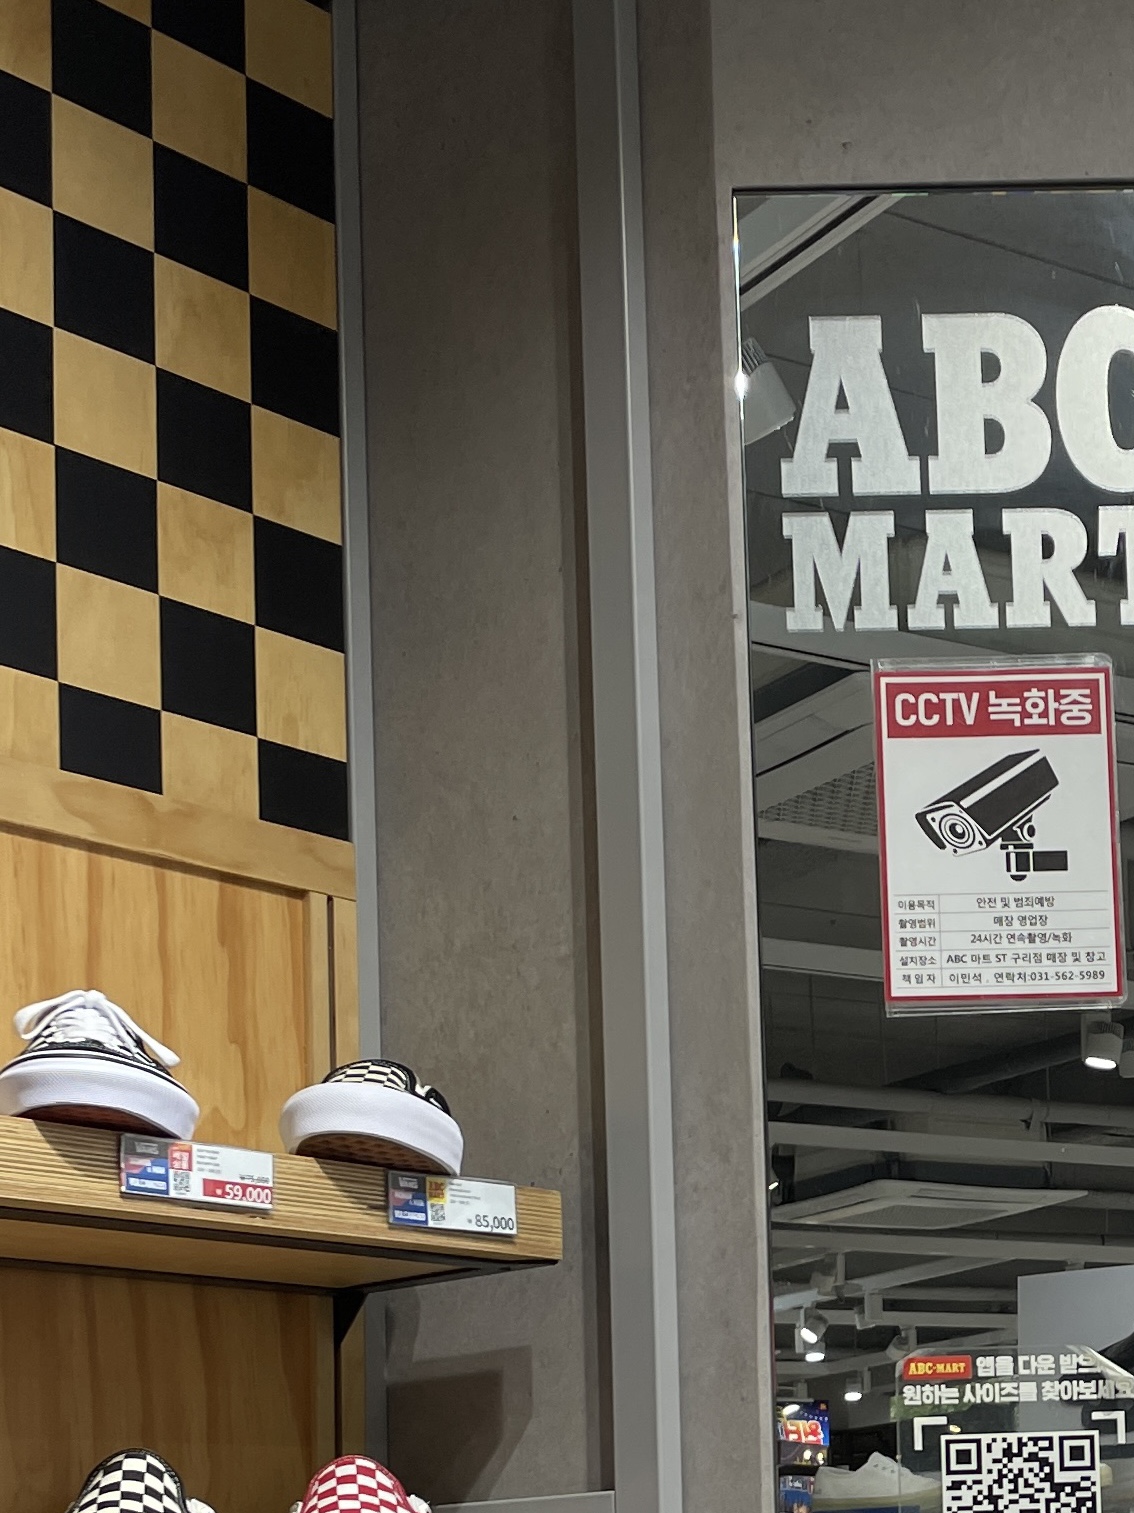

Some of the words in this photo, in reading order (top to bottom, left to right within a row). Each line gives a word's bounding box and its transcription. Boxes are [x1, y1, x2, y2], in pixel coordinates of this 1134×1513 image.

[894, 691, 980, 727] CCTV
[987, 686, 1094, 727] 녹화중
[897, 899, 936, 911] 이용목적
[976, 896, 998, 909] 안전
[1000, 897, 1012, 909] 및
[1013, 895, 1056, 908] 범죄예방
[897, 917, 937, 930] 촬영범위
[993, 915, 1015, 927] 매장
[1016, 914, 1049, 927] 영업장
[899, 936, 938, 948] 촬영시간
[970, 932, 1004, 945] 24시간
[1005, 931, 1073, 945] 연속촬영/녹화
[899, 954, 938, 967] 설치장소
[946, 953, 968, 965] ABC
[970, 953, 993, 966] 마트
[994, 952, 1008, 964] ST
[1010, 952, 1044, 965] 구리점
[1045, 951, 1068, 964] 매장
[1070, 951, 1082, 963] 및
[1084, 950, 1107, 963] 창고
[948, 971, 983, 984] 이민석
[975, 1355, 1015, 1378] 앱을
[1018, 1354, 1056, 1376] 다운
[902, 1383, 960, 1406] 원하는
[963, 1380, 1038, 1405] 사이즈를
[1041, 1378, 1134, 1404] 찾아보세요
